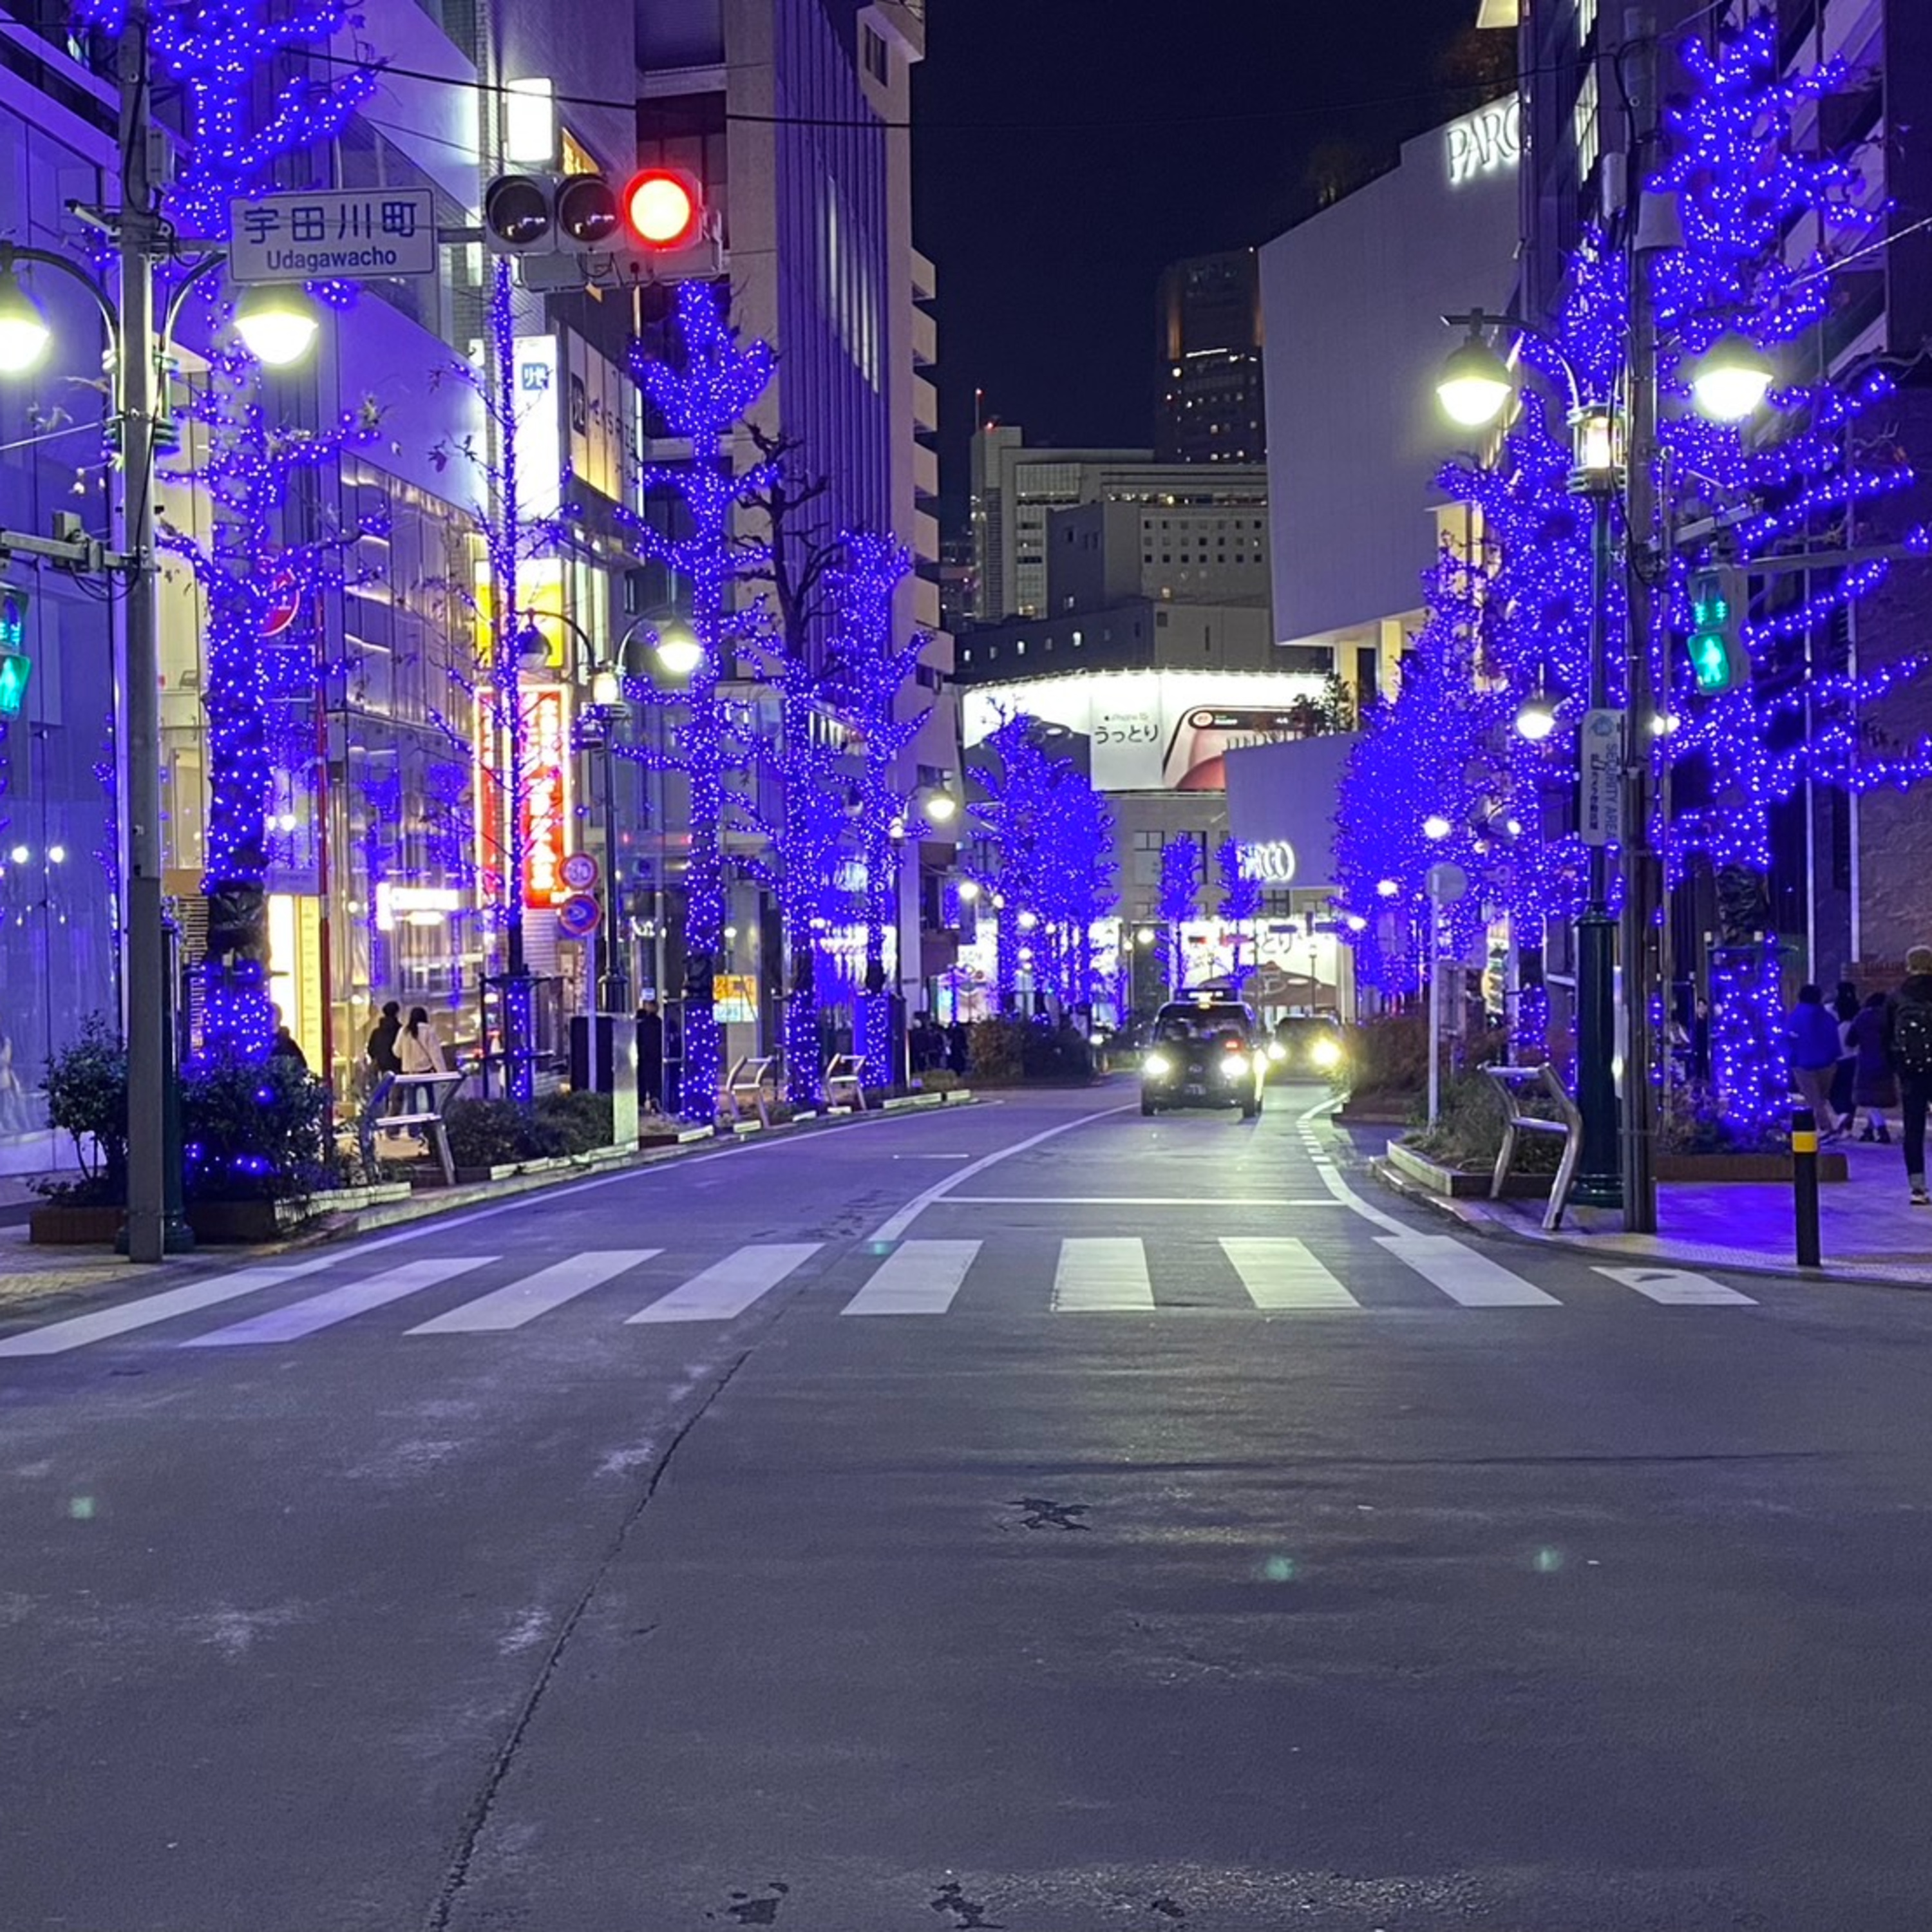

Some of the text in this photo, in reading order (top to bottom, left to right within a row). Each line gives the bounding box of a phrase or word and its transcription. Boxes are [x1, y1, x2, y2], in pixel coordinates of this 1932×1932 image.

[244, 201, 417, 244] 宇田川町
[267, 247, 397, 273] Udagawacho
[1094, 724, 1159, 744] うっとり
[1605, 744, 1619, 803] SECURITY
